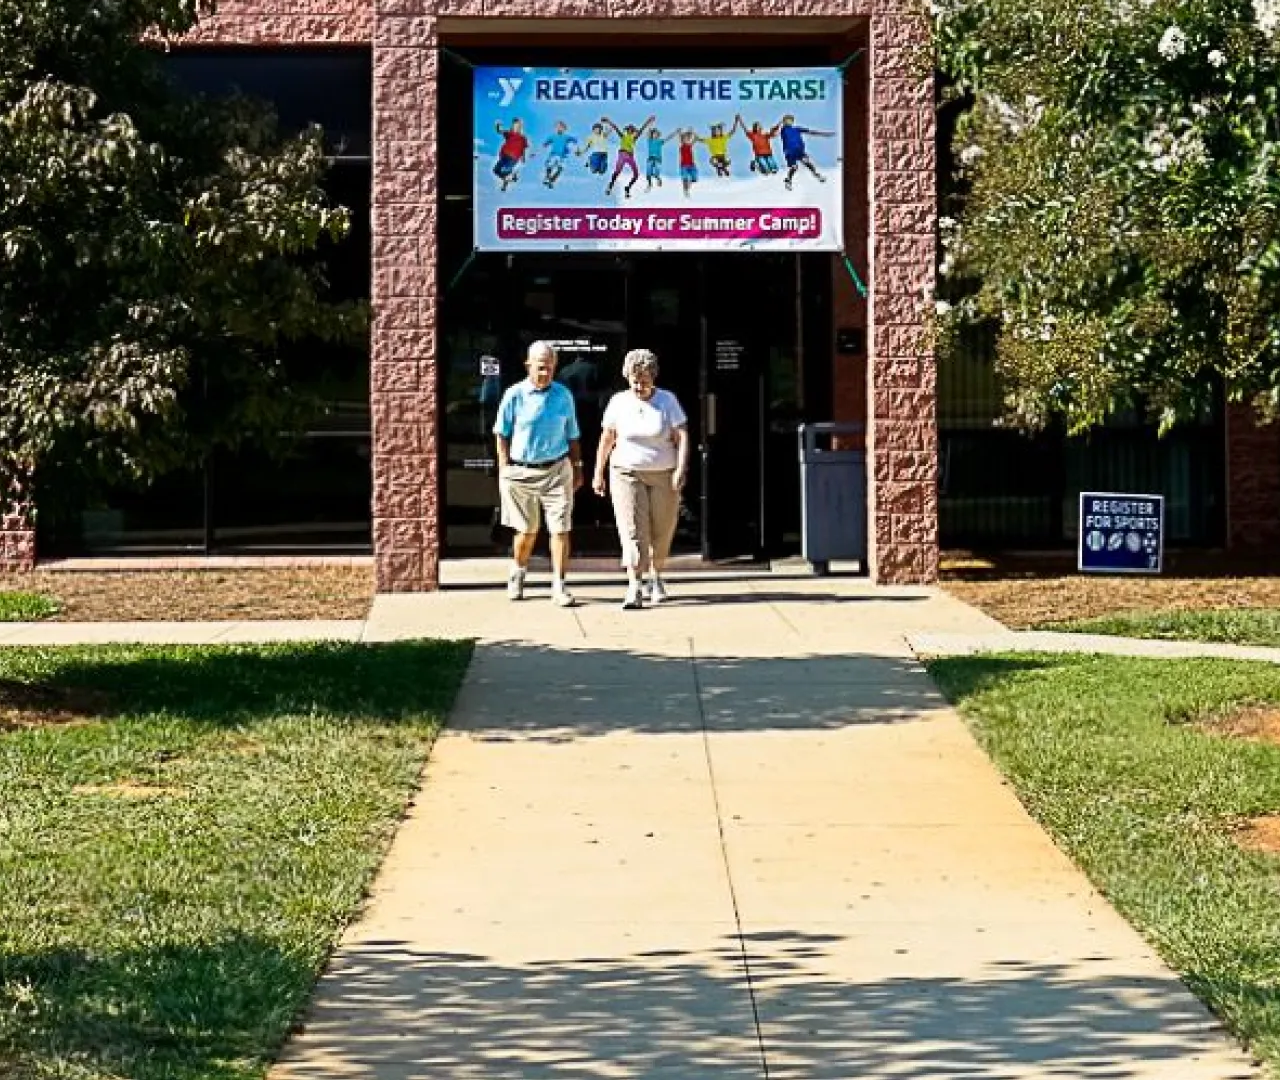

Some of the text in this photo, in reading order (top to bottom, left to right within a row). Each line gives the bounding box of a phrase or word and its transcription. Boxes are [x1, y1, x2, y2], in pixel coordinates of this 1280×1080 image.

[536, 79, 825, 101] REACH FOR THE STARS!
[502, 213, 816, 235] Register Today for Summer Camp!
[1093, 501, 1154, 514] REGISTER
[1086, 515, 1159, 530] FOR SPORTS
